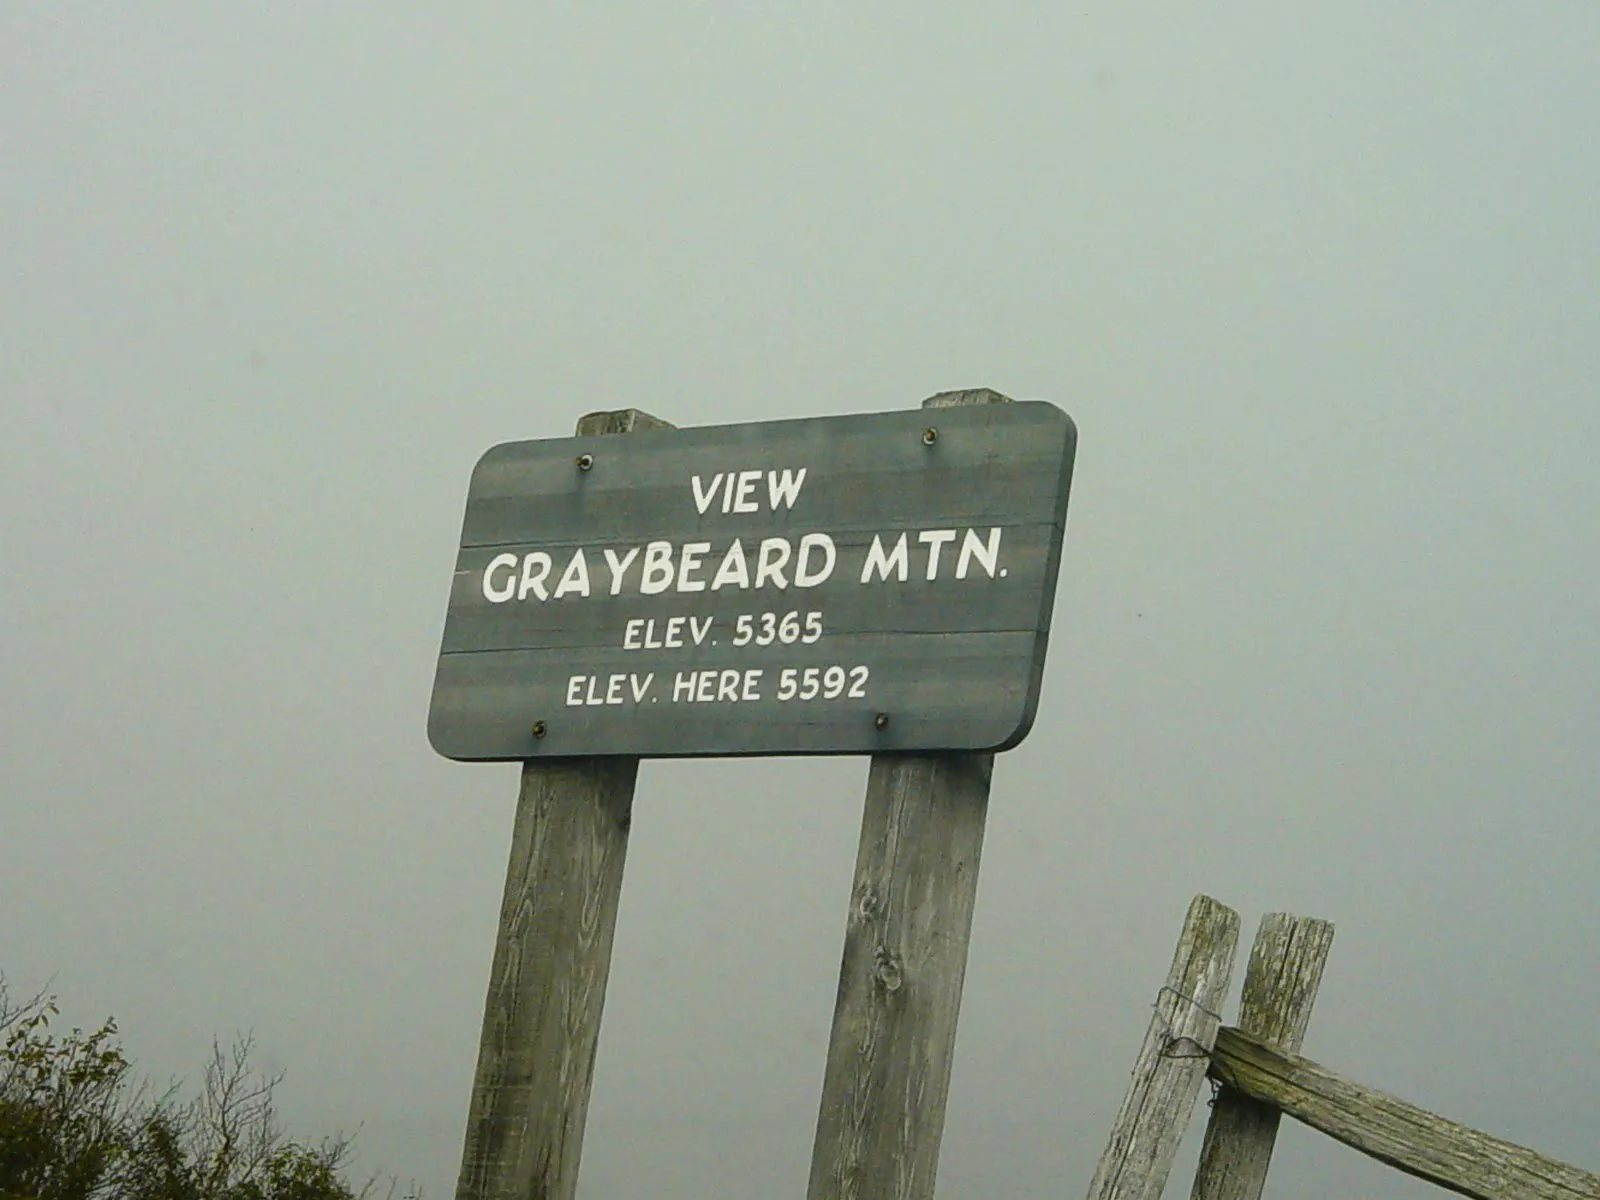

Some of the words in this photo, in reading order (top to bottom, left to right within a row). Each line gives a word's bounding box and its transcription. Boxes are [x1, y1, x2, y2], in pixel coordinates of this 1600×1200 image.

[691, 468, 807, 514] VIEW
[482, 532, 837, 603] GRAYBEARD
[860, 527, 1008, 584] MTN.
[623, 616, 718, 650] ELEV.
[732, 611, 823, 646] 5365
[566, 672, 658, 706] ELEV.
[672, 669, 764, 703] HERE
[777, 665, 870, 701] 5592
